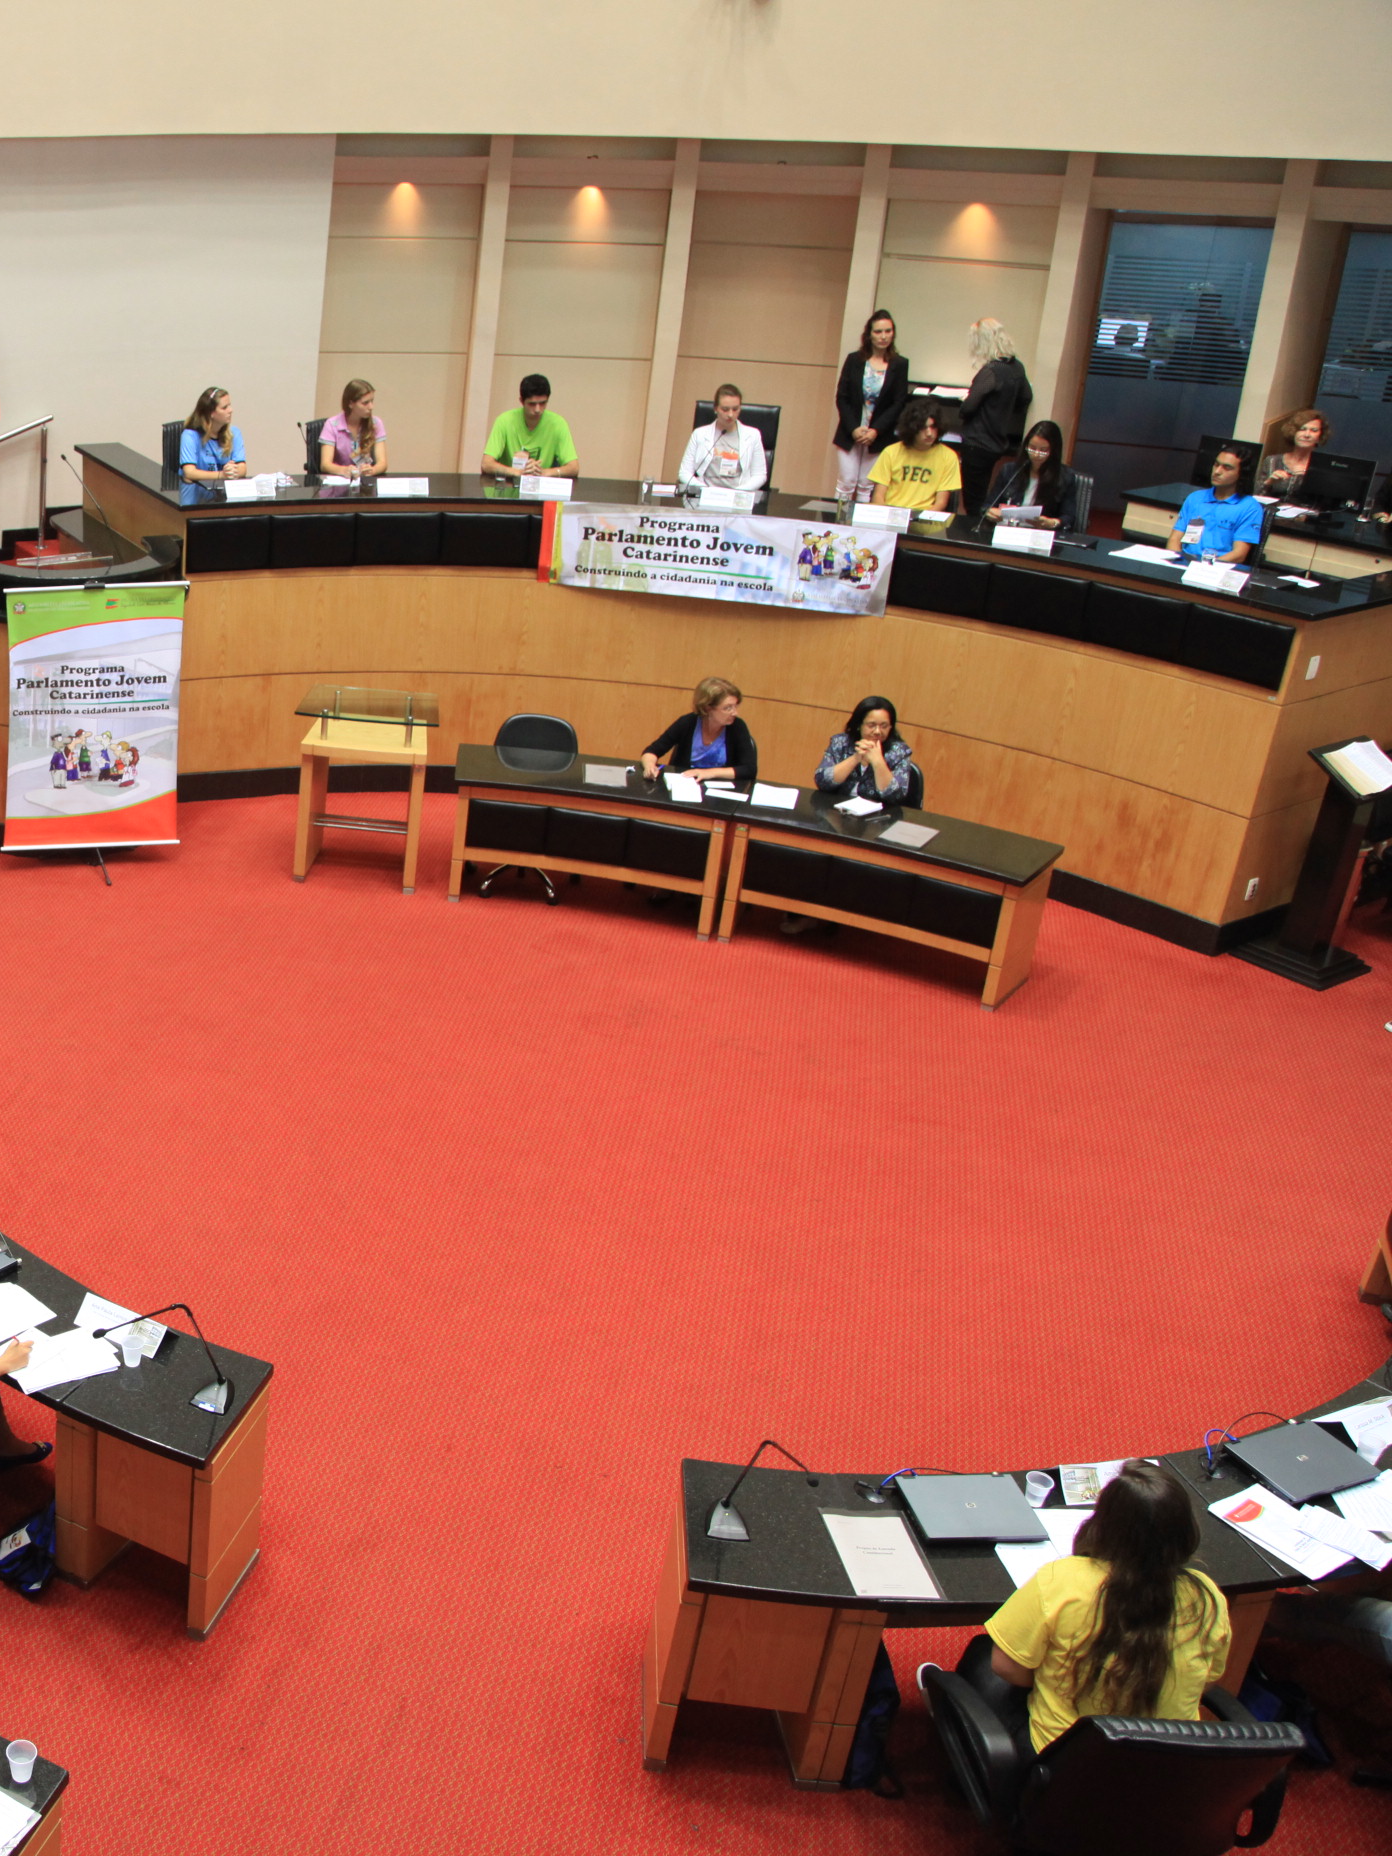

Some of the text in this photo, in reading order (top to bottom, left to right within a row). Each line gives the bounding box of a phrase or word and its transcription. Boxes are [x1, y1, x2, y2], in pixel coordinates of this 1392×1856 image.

[902, 465, 932, 484] PEC
[639, 516, 720, 535] Programa
[582, 526, 775, 558] Parlamento Jovem
[622, 545, 729, 567] Catarinense
[574, 564, 648, 580] Construindo
[659, 571, 717, 588] cidadania
[720, 579, 735, 588] na
[737, 580, 774, 593] escola
[60, 663, 125, 676] Programa
[16, 673, 168, 690] Parlamento Jovem
[49, 689, 135, 701] Catarinense
[12, 707, 72, 717] Construindo
[81, 705, 126, 715] cidadania
[142, 703, 170, 712] escola
